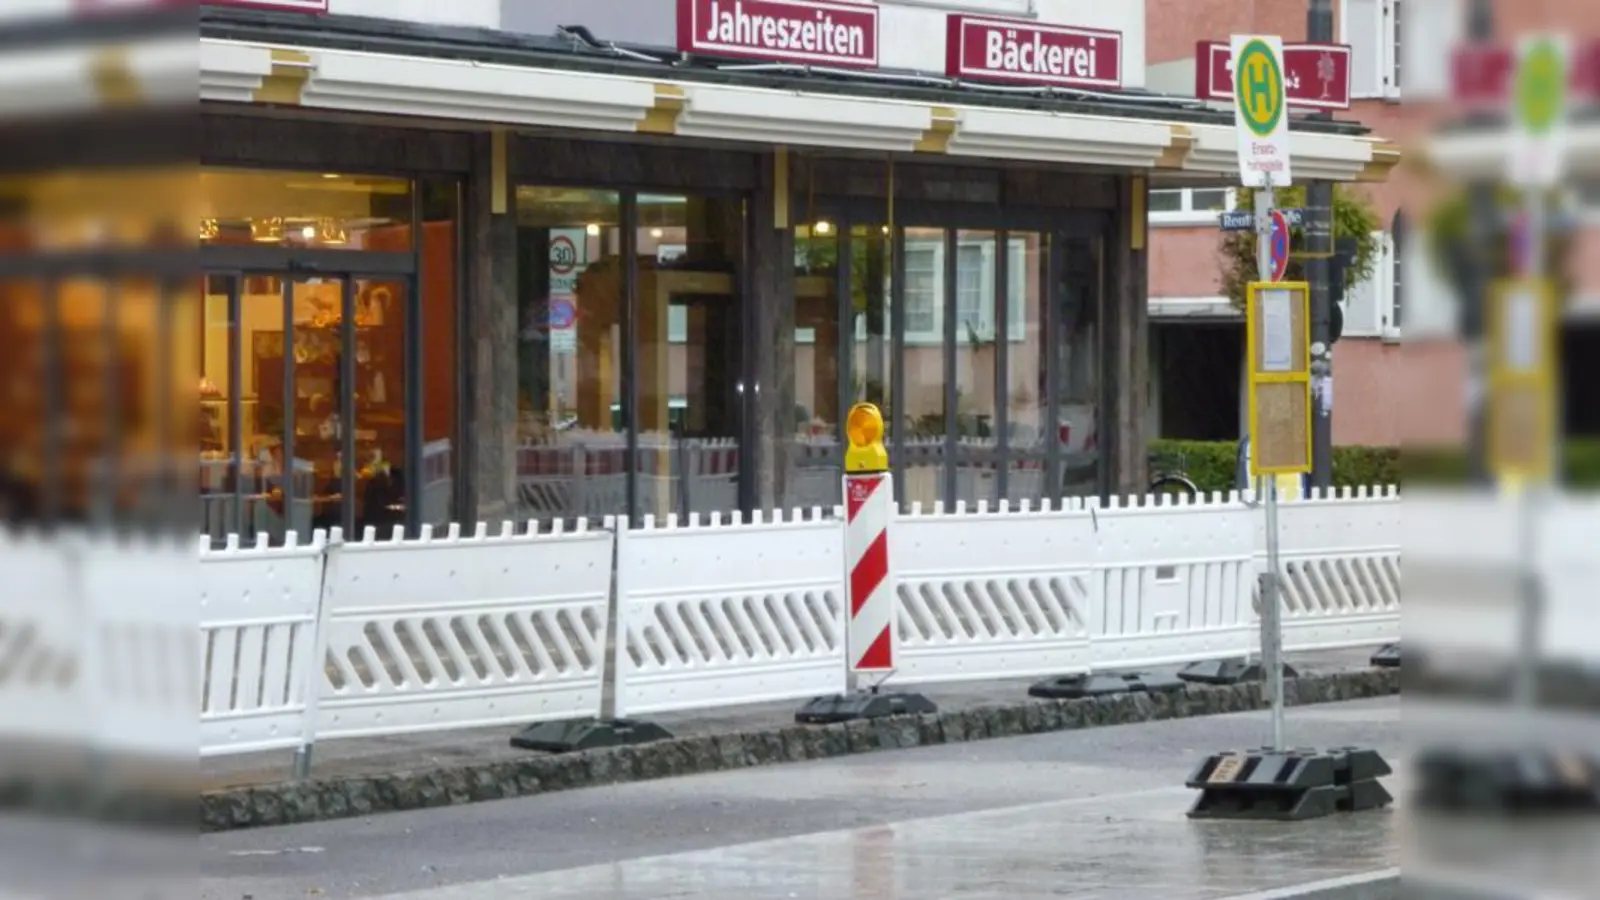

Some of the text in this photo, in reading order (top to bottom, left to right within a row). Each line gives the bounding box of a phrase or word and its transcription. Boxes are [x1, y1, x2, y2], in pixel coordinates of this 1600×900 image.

[706, 2, 864, 55] Jahreszeiten
[985, 30, 1097, 77] Bäckerei
[1249, 64, 1272, 112] H
